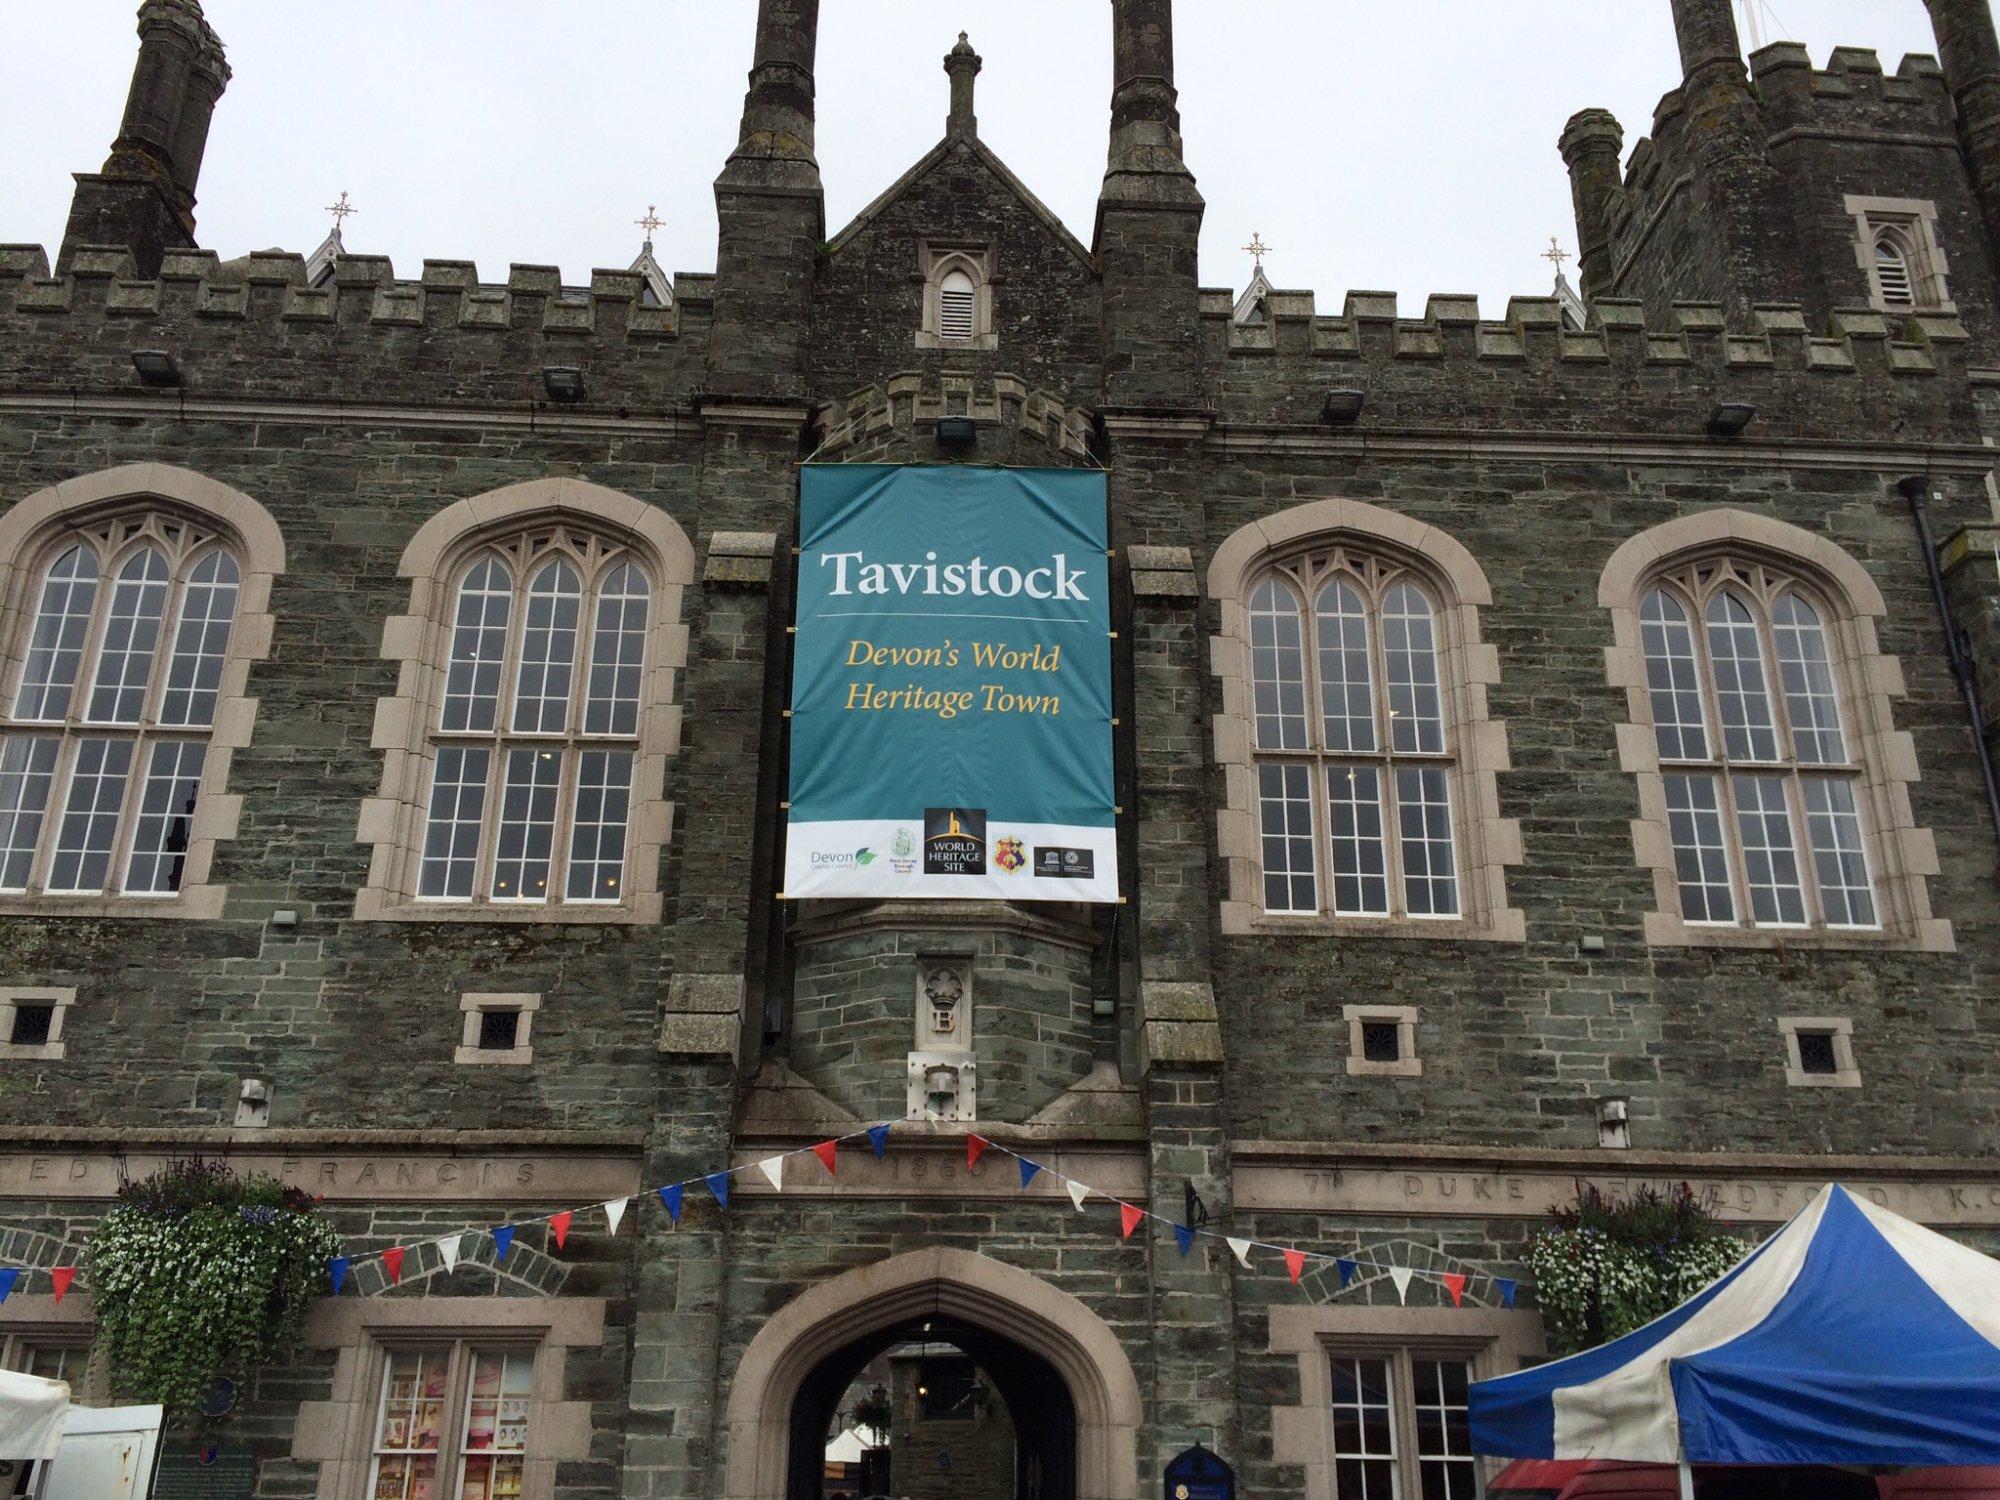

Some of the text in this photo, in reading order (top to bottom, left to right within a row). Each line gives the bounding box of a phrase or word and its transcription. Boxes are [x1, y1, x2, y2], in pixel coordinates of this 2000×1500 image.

[820, 550, 1090, 601] Tavistock
[845, 639, 1061, 672] Devon's World
[844, 682, 1061, 718] Heritage Town
[810, 851, 853, 863] Devon
[929, 852, 980, 862] HERITAGE
[934, 842, 976, 851] WORLD
[943, 862, 965, 872] SITE
[281, 1162, 536, 1186] FRANCIS
[890, 1156, 988, 1181] 1860
[1403, 1174, 1524, 1200] DUKE
